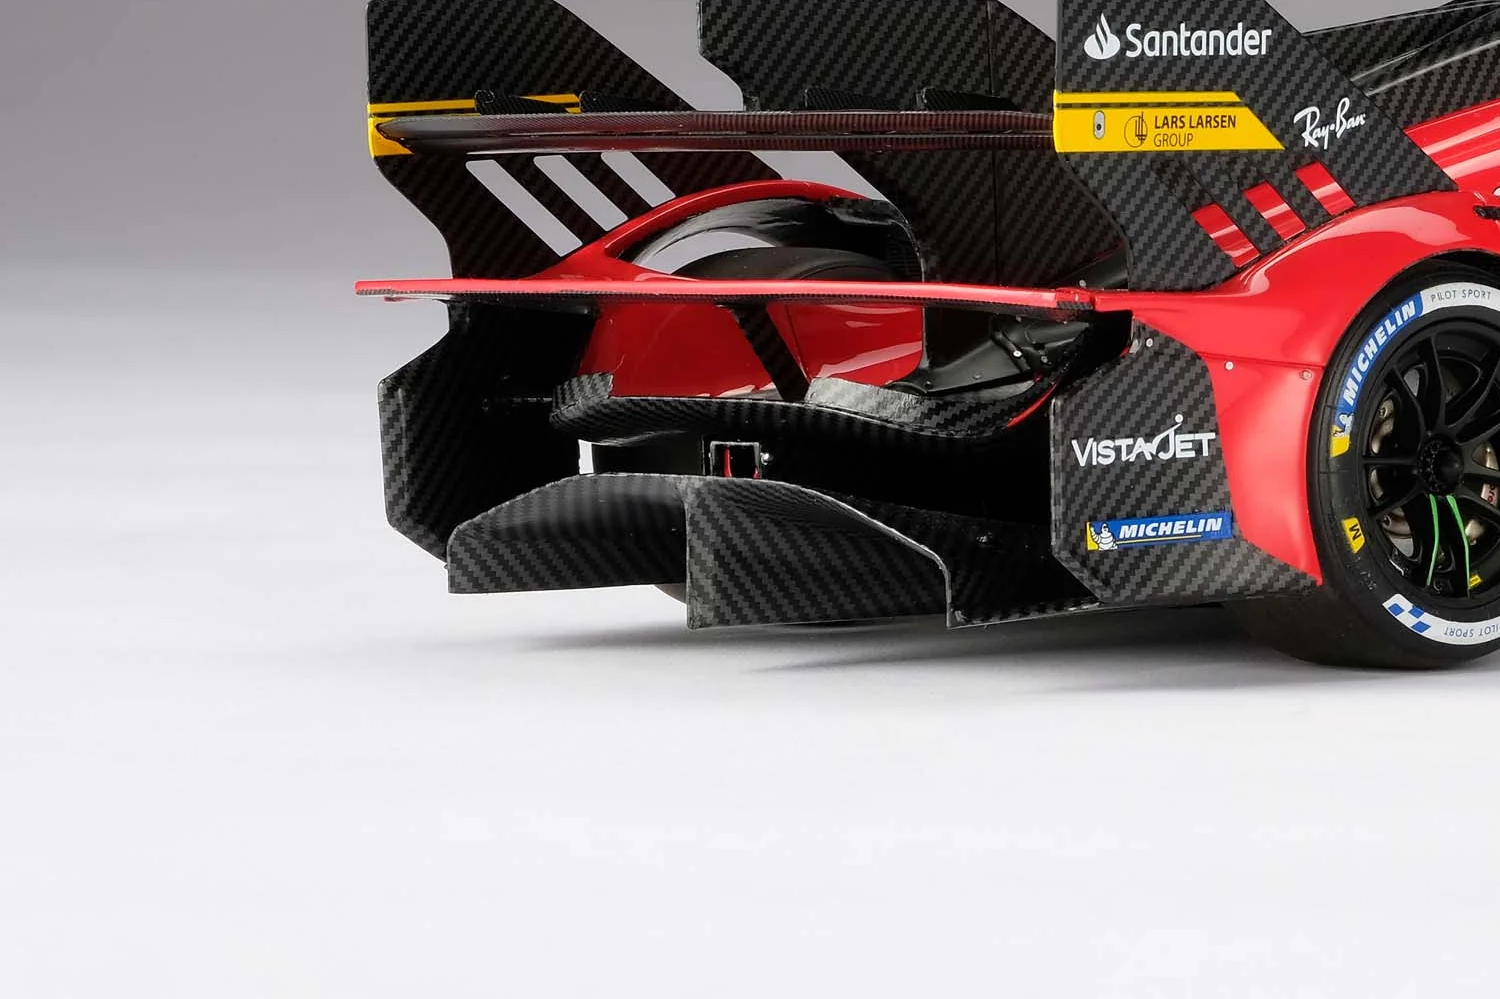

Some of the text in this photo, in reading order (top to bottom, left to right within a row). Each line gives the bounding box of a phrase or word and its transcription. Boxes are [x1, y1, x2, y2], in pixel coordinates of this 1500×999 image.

[1125, 21, 1272, 58] Santander
[1154, 114, 1237, 130] LARS LARSEN
[1153, 133, 1194, 148] GROUP
[1430, 288, 1492, 302] PILOT SPORT
[1343, 300, 1416, 407] MICHELIN
[1118, 517, 1223, 539] MICHELIN
